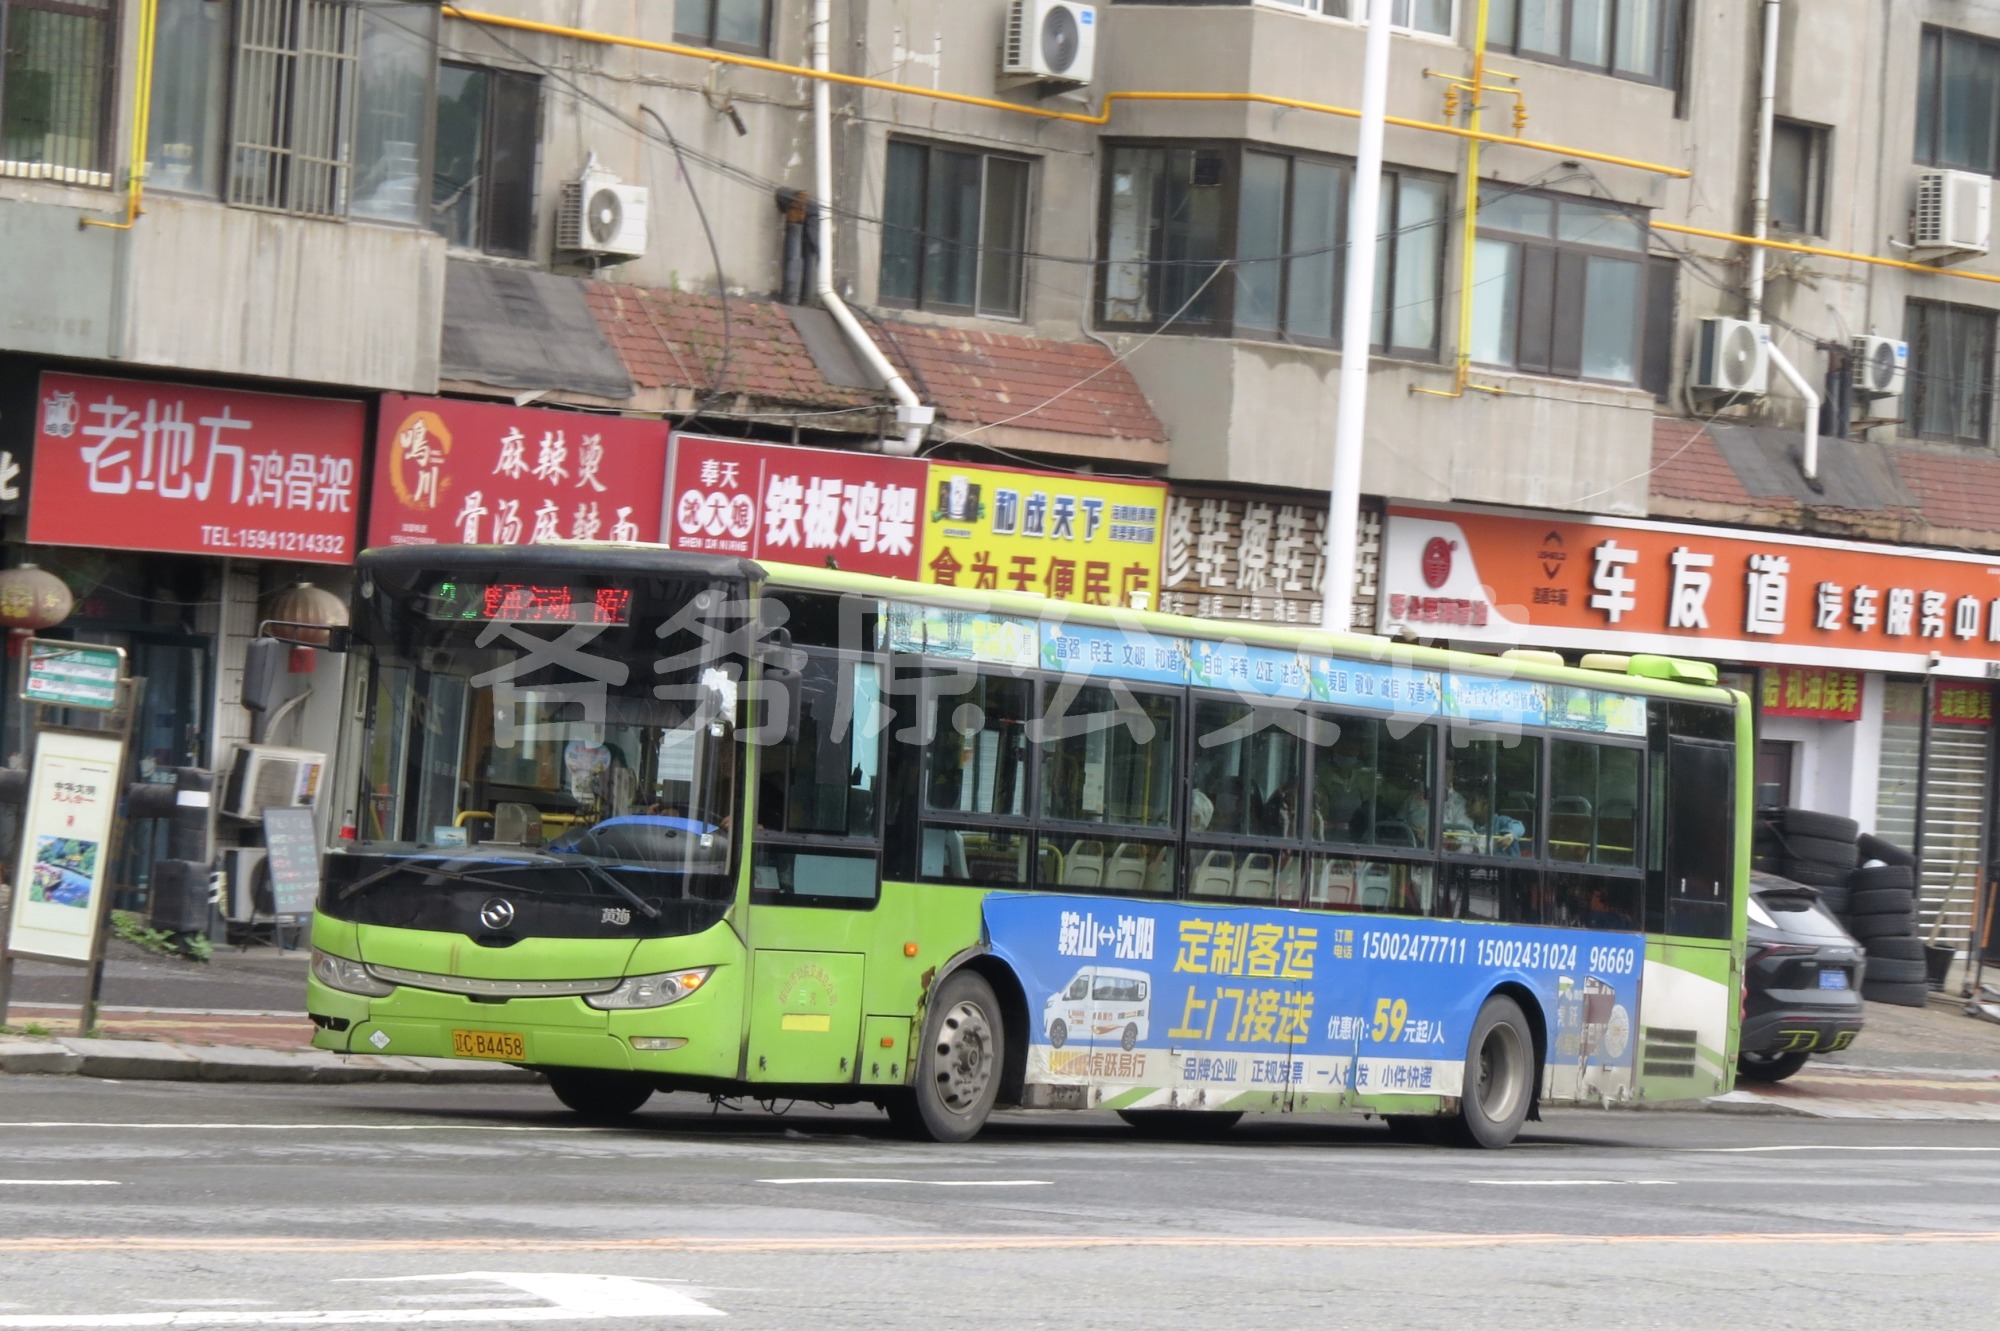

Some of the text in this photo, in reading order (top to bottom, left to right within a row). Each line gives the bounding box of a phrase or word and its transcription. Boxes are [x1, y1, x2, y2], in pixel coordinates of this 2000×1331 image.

[80, 396, 253, 504] 老地方
[247, 450, 354, 513] 鸡骨架
[492, 426, 608, 492] 麻辣烫
[700, 459, 740, 489] 奉天
[681, 496, 751, 530] 沈大娘
[765, 474, 918, 557] 铁板鸡架
[992, 488, 1104, 542] 和成天下
[1591, 539, 1791, 635] 车友道
[1056, 636, 1080, 660] 富强
[1090, 640, 1113, 664] 民主
[1122, 644, 1146, 667] 文明
[1155, 647, 1179, 671] 和谐
[1203, 654, 1223, 676] 自由
[1229, 657, 1248, 680] 平等
[1255, 661, 1273, 683] 公正
[1328, 671, 1425, 702] 爱国 敬业 诚信 友善
[601, 907, 631, 925] 黄海
[1173, 917, 1318, 980] 定制客运
[1333, 945, 1353, 959] 电话
[1362, 931, 1634, 974] 15002477711 15002431024 96669
[1168, 985, 1315, 1044] 上门接送
[1091, 1053, 1146, 1078] 虎跃易行
[1183, 1058, 1237, 1083] 品牌企业
[1251, 1060, 1305, 1085] 正规发票
[1382, 1065, 1433, 1088] 小件快递
